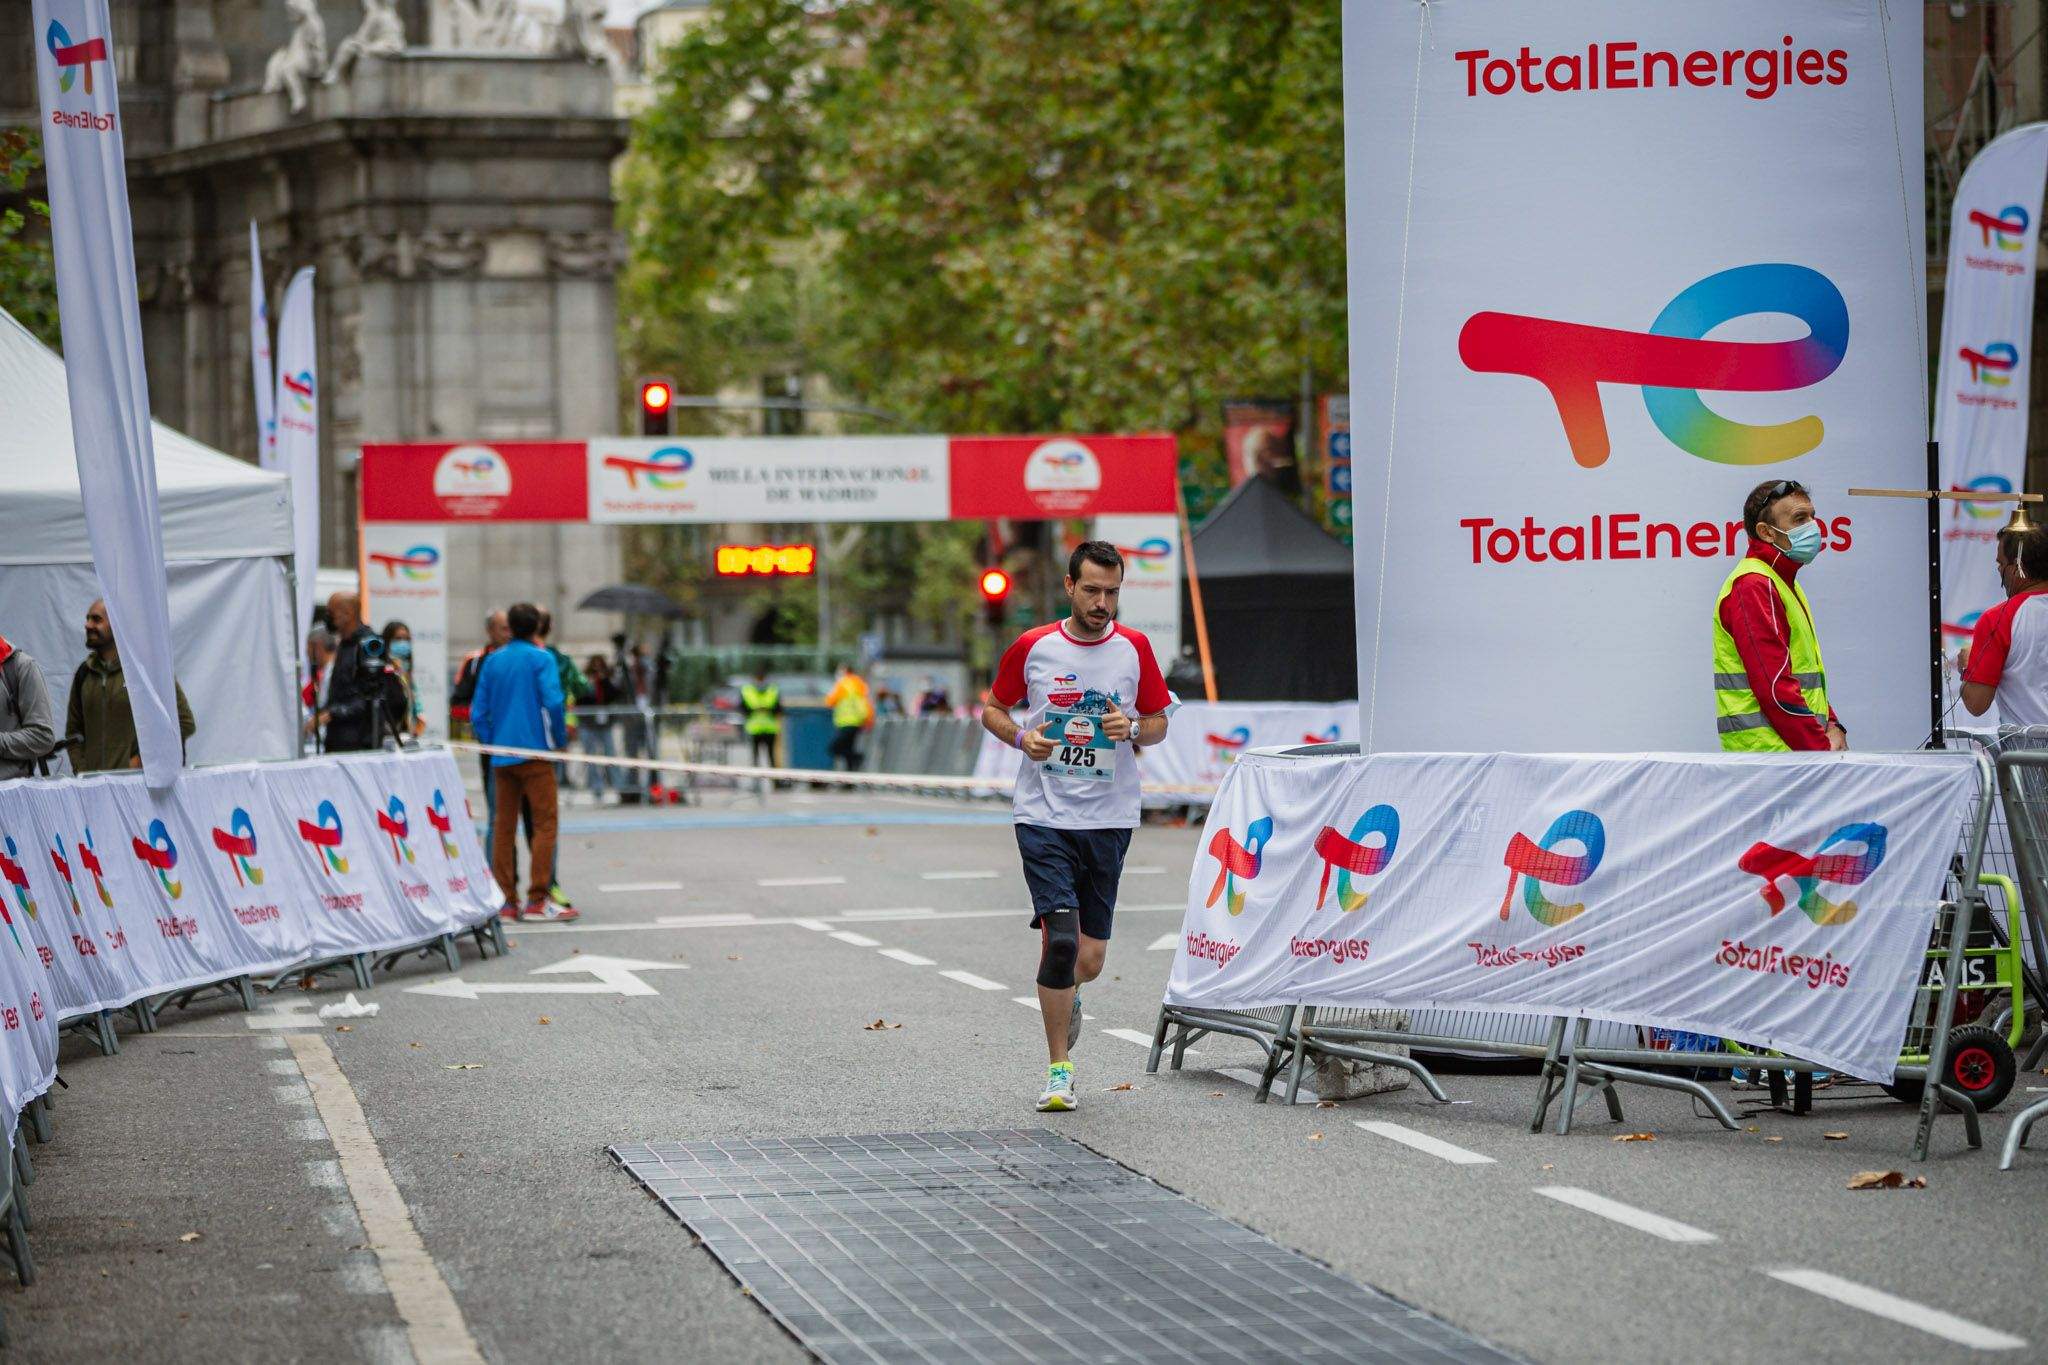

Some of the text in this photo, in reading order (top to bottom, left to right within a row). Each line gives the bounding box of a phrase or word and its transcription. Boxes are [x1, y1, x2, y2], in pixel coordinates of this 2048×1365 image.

[1455, 35, 1848, 100] TotalEnergies
[1460, 513, 1852, 563] TotalEners
[1060, 746, 1096, 767] 425
